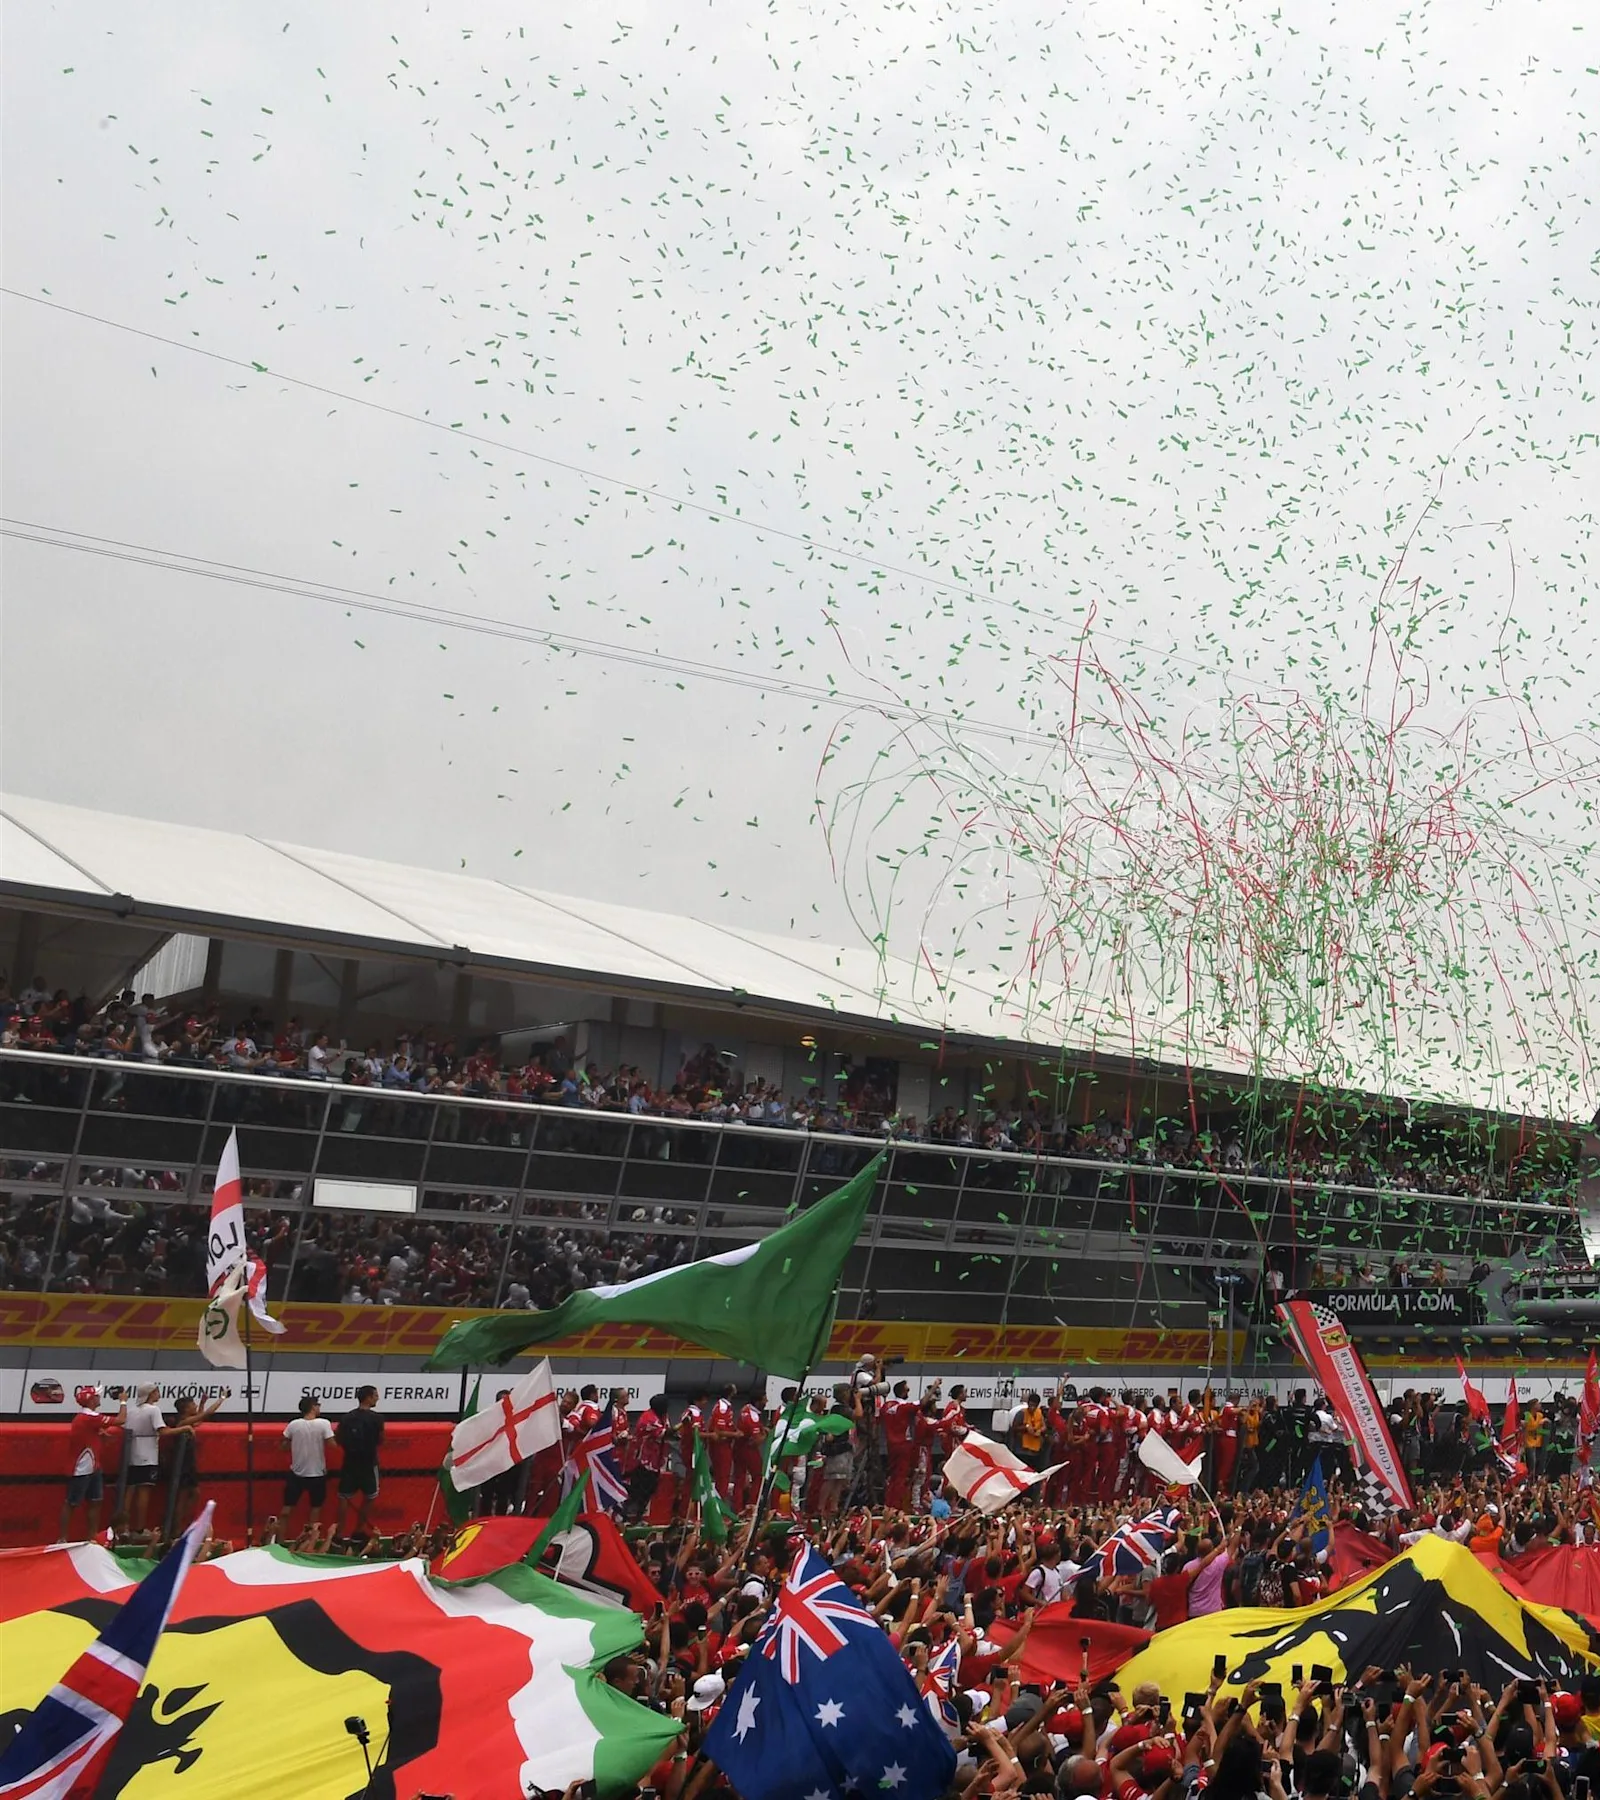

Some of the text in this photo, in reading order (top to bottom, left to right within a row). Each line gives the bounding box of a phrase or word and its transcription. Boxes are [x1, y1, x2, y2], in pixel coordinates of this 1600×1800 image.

[1328, 1294, 1455, 1311] FORMULA 1.COM
[271, 1308, 444, 1346] DHL
[944, 1328, 1072, 1358] DHL
[1122, 1332, 1215, 1358] DHL
[103, 1386, 136, 1399] KMI
[152, 1381, 232, 1399] ÄIKKÖNEN
[301, 1386, 449, 1400] SCUDE FERRARI
[965, 1387, 992, 1399] LEWIS
[1212, 1387, 1269, 1398] ERCEDES AMG
[1517, 1386, 1531, 1395] FOM
